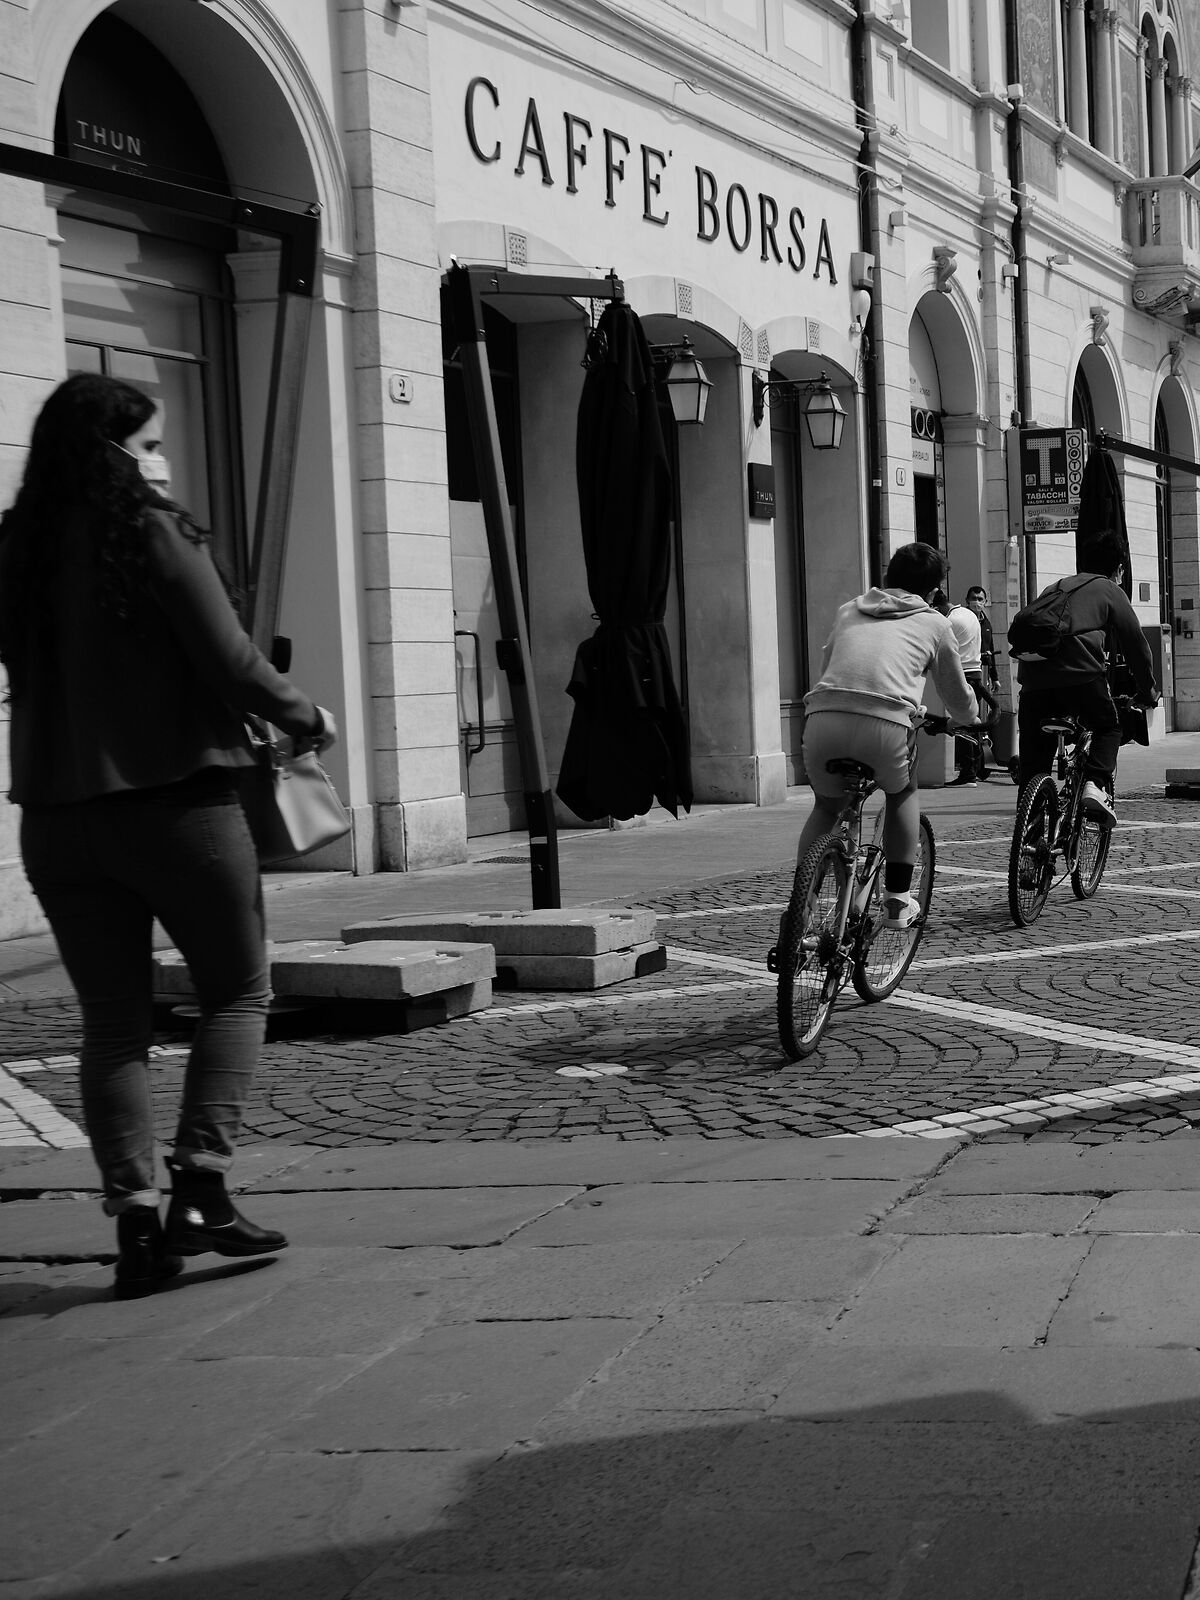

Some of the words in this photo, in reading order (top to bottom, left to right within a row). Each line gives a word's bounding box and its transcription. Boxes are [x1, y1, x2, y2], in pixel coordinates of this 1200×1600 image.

[77, 120, 141, 156] THUN
[695, 165, 839, 285] BORSA
[1026, 437, 1062, 485] T
[1067, 435, 1081, 496] LOTTO
[1026, 491, 1067, 500] TABACCHI
